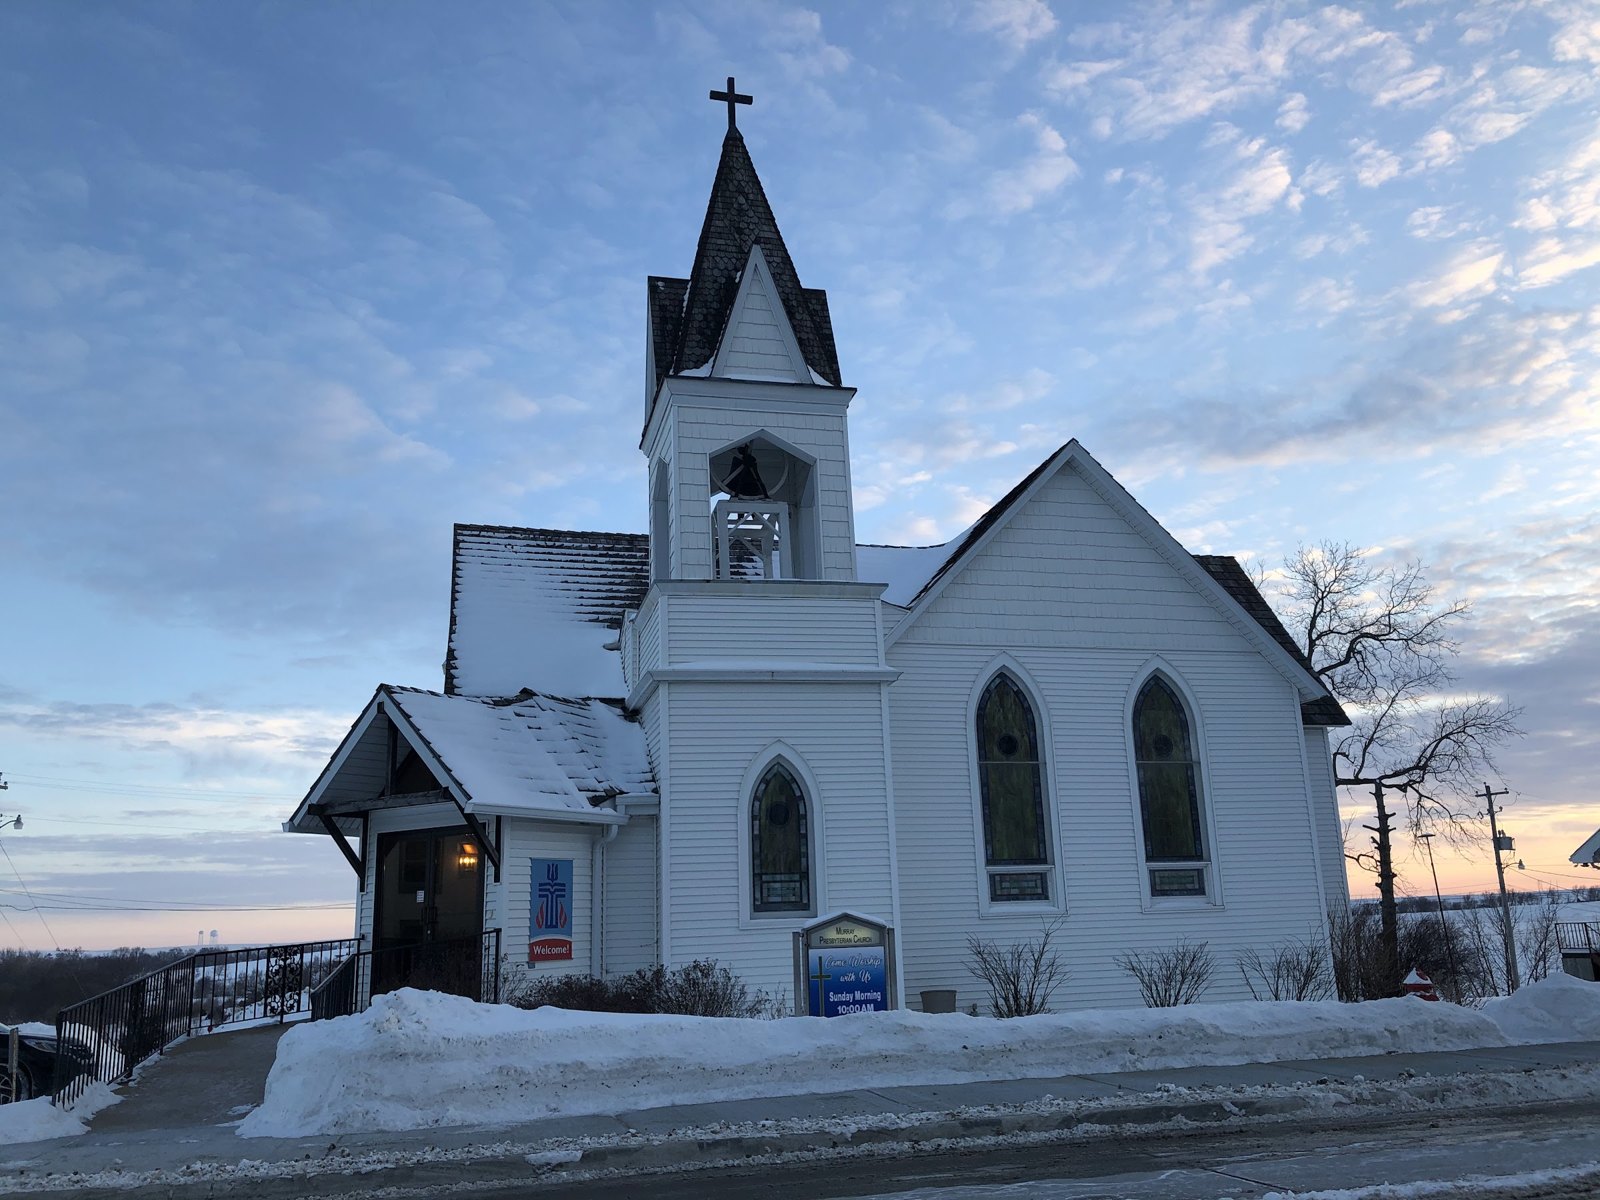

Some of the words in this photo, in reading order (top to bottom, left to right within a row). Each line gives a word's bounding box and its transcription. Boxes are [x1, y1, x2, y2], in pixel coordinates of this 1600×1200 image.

[836, 927, 855, 935] MURRAY
[819, 936, 853, 945] PRESBYTERIAN
[853, 935, 872, 943] CHURCH
[533, 945, 569, 955] Welcome!
[826, 956, 845, 969] Come
[848, 953, 881, 968] Worship
[840, 972, 855, 982] with
[859, 970, 871, 983] Us
[829, 991, 854, 1002] Sunday
[855, 990, 881, 1001] Morning
